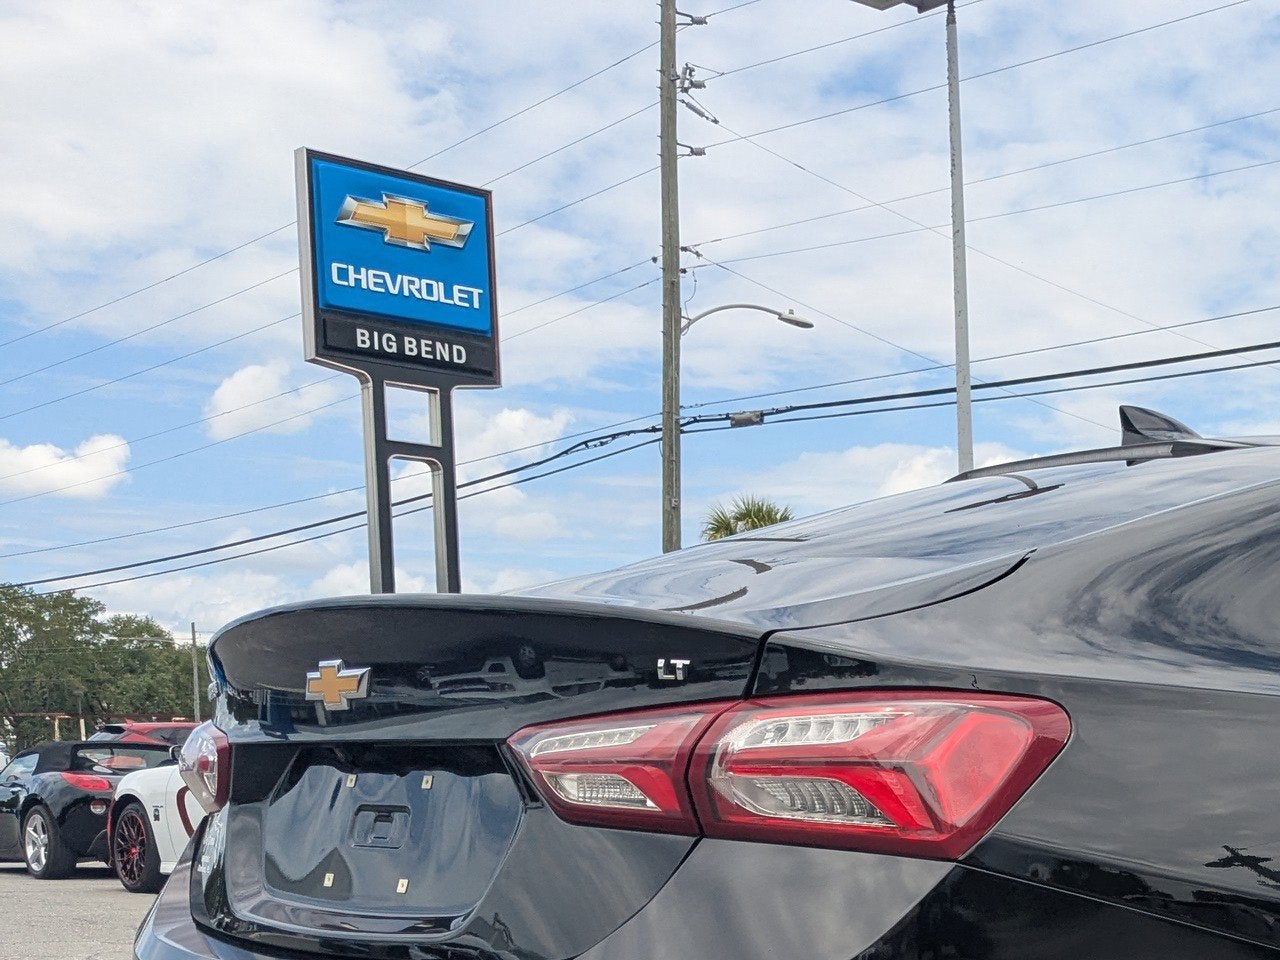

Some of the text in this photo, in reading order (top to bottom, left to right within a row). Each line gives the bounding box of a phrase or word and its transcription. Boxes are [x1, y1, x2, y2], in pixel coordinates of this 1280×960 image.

[331, 262, 484, 310] CHEVROLET
[356, 328, 467, 364] BIG BEND
[657, 658, 691, 681] LT
